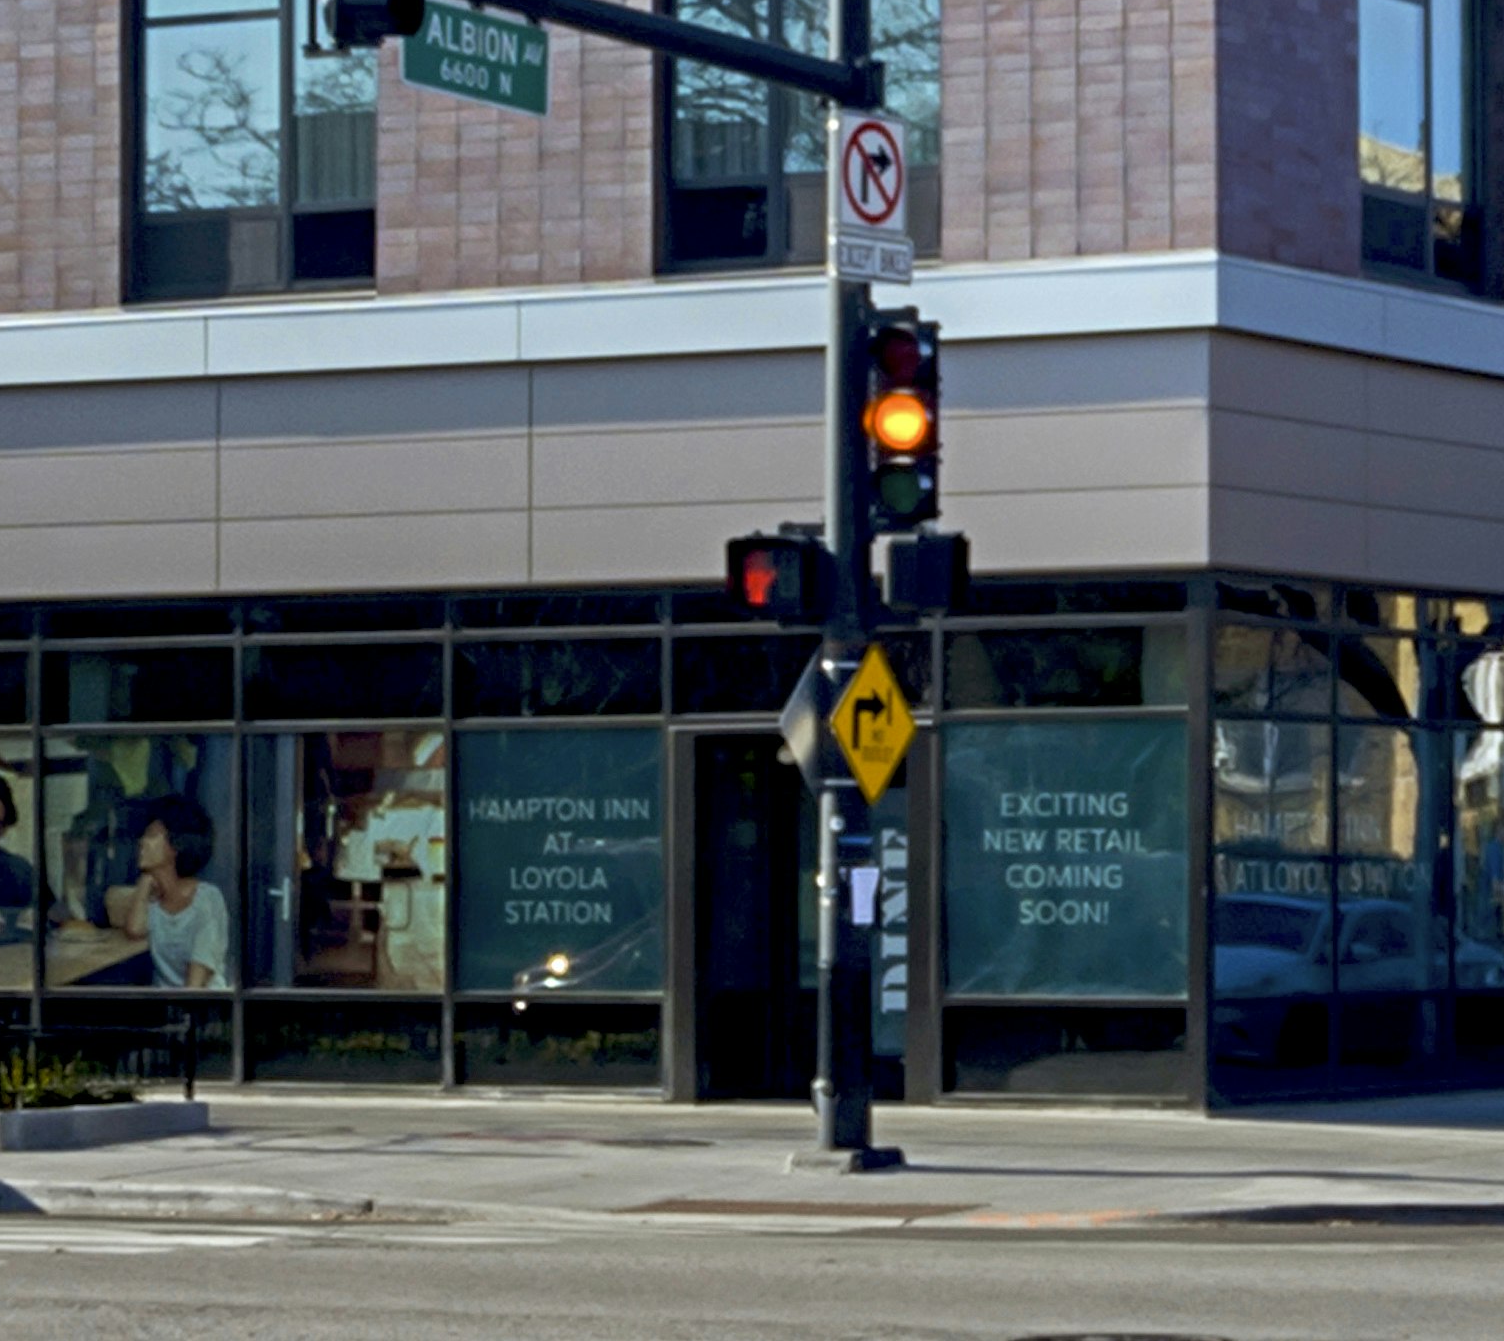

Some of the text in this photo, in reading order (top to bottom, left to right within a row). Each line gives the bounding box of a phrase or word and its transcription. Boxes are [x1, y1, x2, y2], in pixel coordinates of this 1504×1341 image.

[426, 12, 519, 66] ALBION
[439, 57, 513, 96] 6600 N
[469, 798, 650, 821] HAMPTON INN
[1000, 792, 1129, 818] EXCITING
[543, 831, 572, 856] AT
[982, 828, 1146, 853] NEW RETAIL
[509, 866, 609, 890] LOYOLA
[1005, 864, 1124, 890] COMING
[504, 900, 612, 925] STATION
[1019, 899, 1110, 925] SOON!
